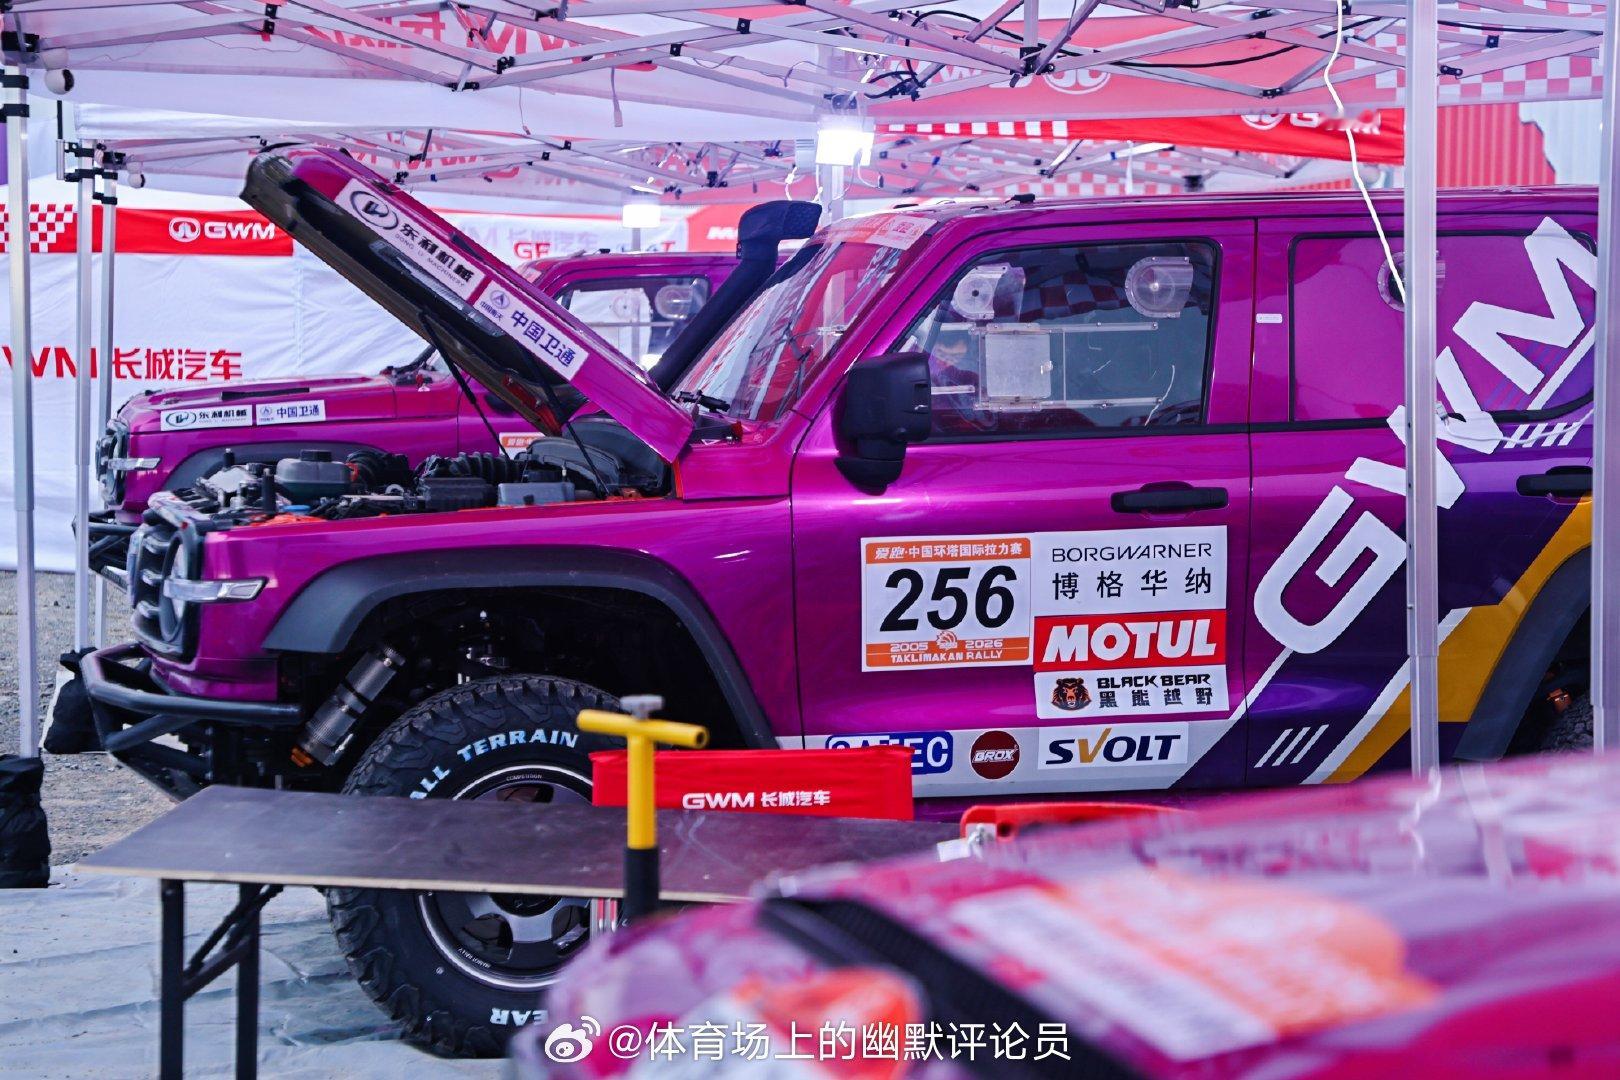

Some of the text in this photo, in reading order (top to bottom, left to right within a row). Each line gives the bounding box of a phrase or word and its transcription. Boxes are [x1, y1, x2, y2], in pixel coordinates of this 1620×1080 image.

[204, 221, 276, 240] GWM
[400, 223, 475, 282] 东利机械
[511, 310, 577, 367] 中国卫通
[113, 348, 242, 380] 长城汽车
[276, 404, 320, 419] 中国卫通
[1254, 216, 1597, 654] GWM
[1052, 543, 1212, 563] BORGWARNER
[879, 565, 1018, 632] 256
[1052, 567, 1212, 600] 博格华纳
[890, 639, 1003, 652] 2005 2026
[1042, 618, 1217, 663] MOTUL
[891, 650, 1003, 664] TAKLIMAKAN RALLY
[1097, 673, 1212, 690] BLACK BEAR
[456, 728, 579, 762] TERRAIN
[972, 748, 1018, 763] BROX
[1046, 727, 1182, 765] SVOLT
[682, 789, 831, 810] GWM 长城汽车
